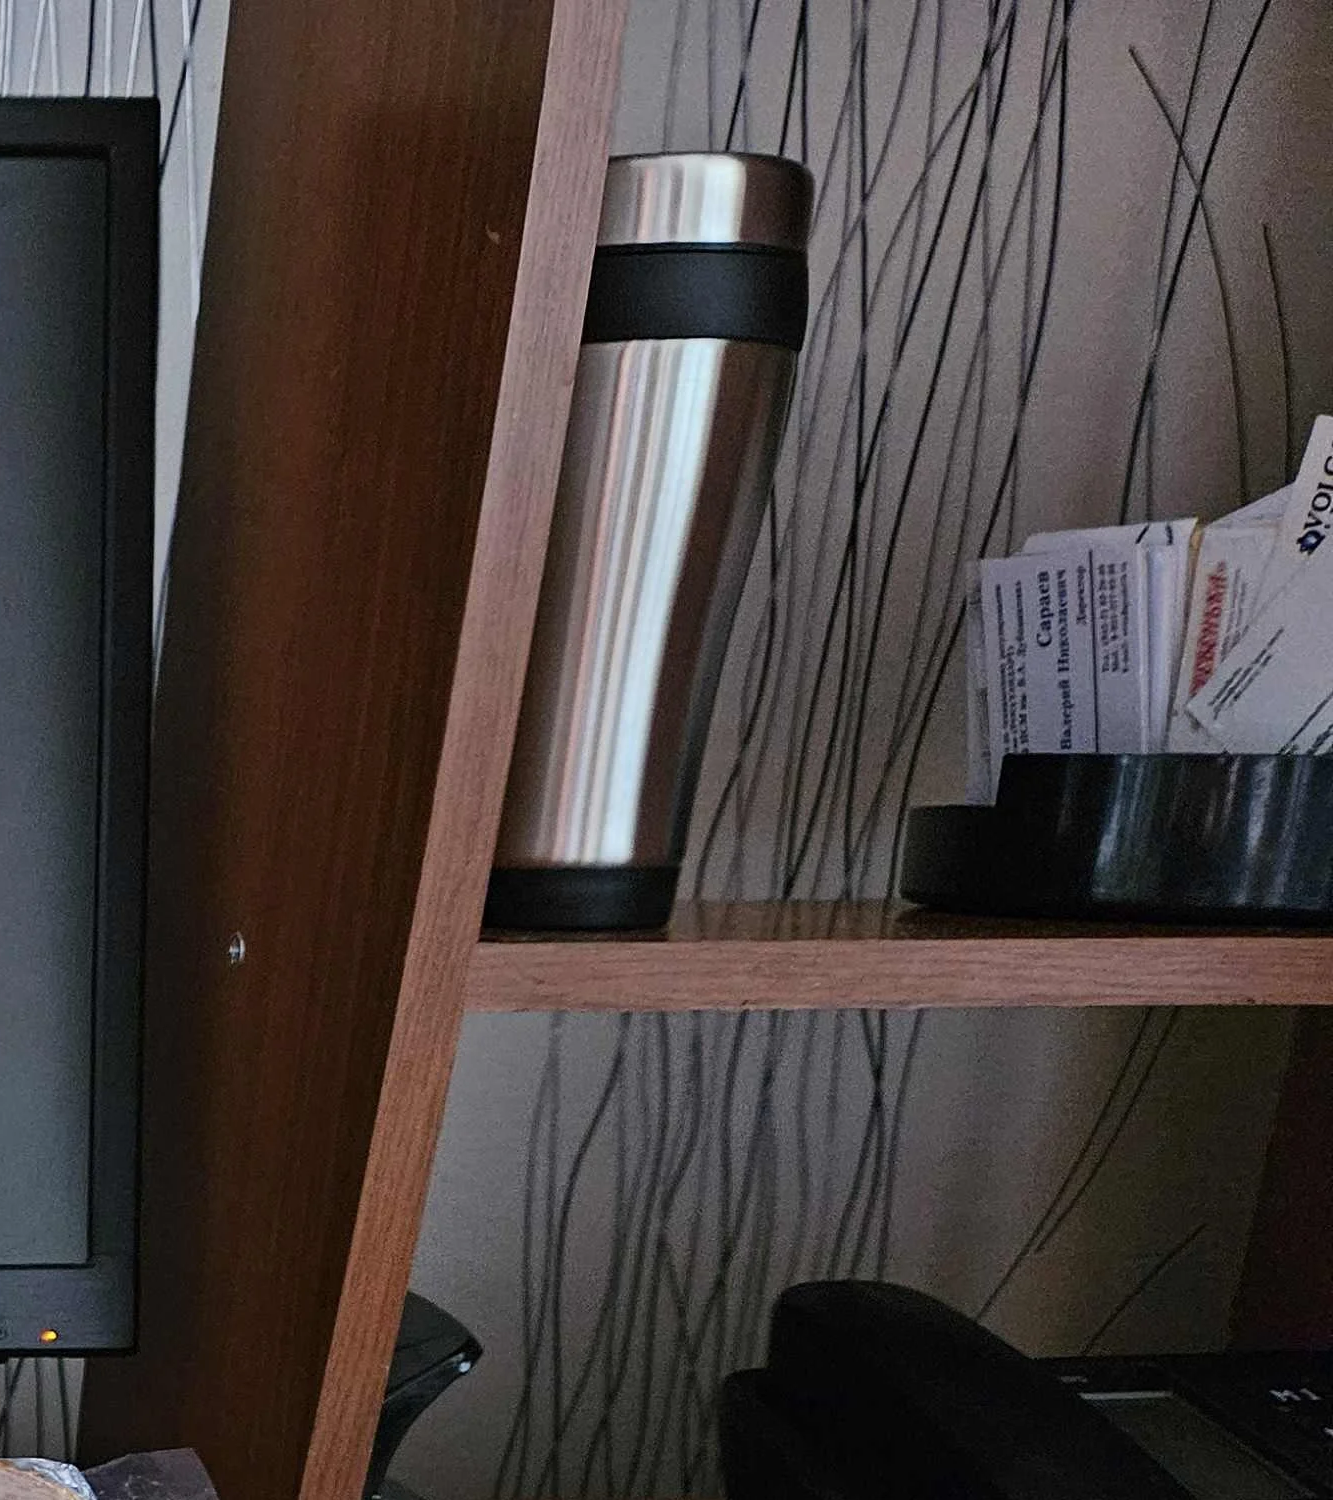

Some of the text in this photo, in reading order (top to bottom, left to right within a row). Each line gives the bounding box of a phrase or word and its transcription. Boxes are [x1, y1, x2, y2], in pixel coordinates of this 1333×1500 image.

[1304, 443, 1333, 529] VOL
[1035, 570, 1054, 648] Сараев
[1055, 568, 1075, 750] Валерий Николаевич
